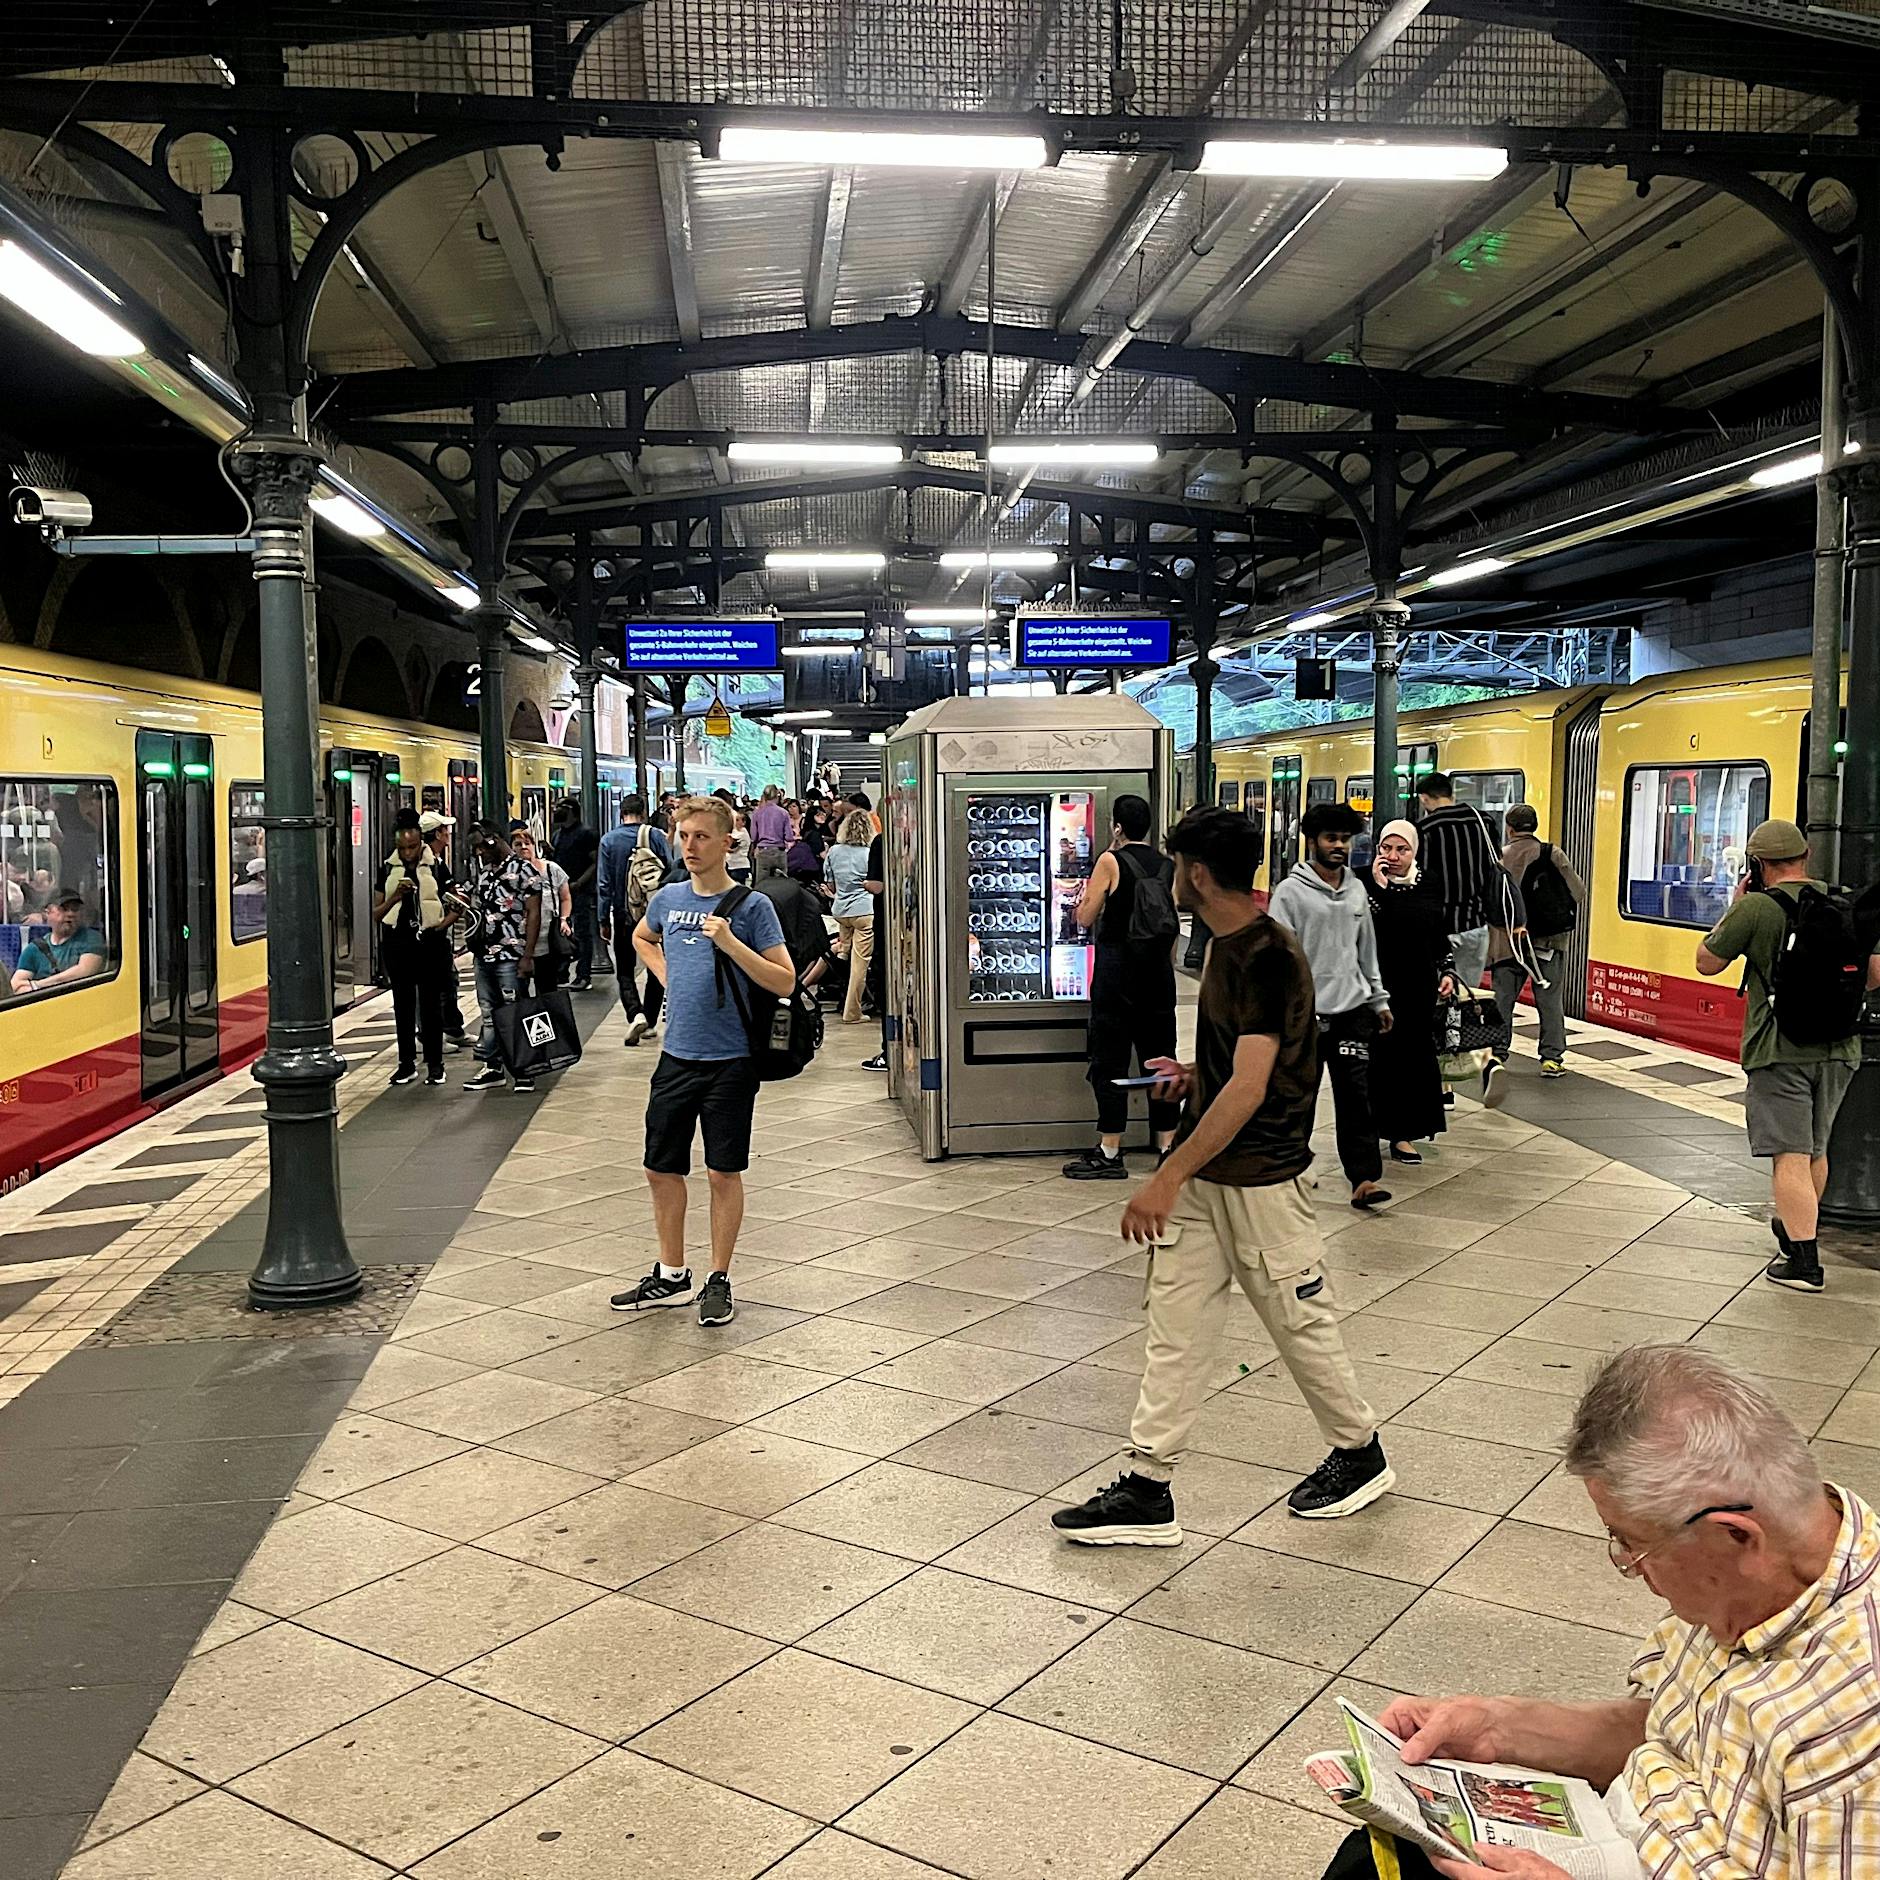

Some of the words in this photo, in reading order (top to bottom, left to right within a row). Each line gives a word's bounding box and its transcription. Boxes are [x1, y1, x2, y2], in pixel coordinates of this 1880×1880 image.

[629, 629, 659, 637] Unwetter!
[660, 629, 667, 637] Zu
[668, 629, 682, 637] Ihrer
[683, 629, 713, 637] Sicherheit
[713, 629, 721, 637] ist
[722, 629, 732, 637] der
[1066, 626, 1080, 634] Ihrer
[1080, 626, 1109, 634] Sicherheit
[1109, 626, 1117, 634] ist
[1118, 626, 1128, 634] der
[629, 642, 655, 650] gesamte
[655, 641, 698, 649] S-Bahnverkehr
[699, 641, 732, 650] eingestellt.
[732, 641, 758, 649] Weichen
[1027, 639, 1052, 647] gesamte
[1053, 638, 1094, 646] S-Bahnverkehr
[1095, 638, 1127, 647] eingestellt.
[1127, 638, 1152, 646] Weichen
[630, 653, 640, 661] Sie
[640, 653, 650, 661] auf
[727, 653, 739, 661] aus.
[466, 663, 481, 695] 2
[1318, 660, 1331, 690] 1
